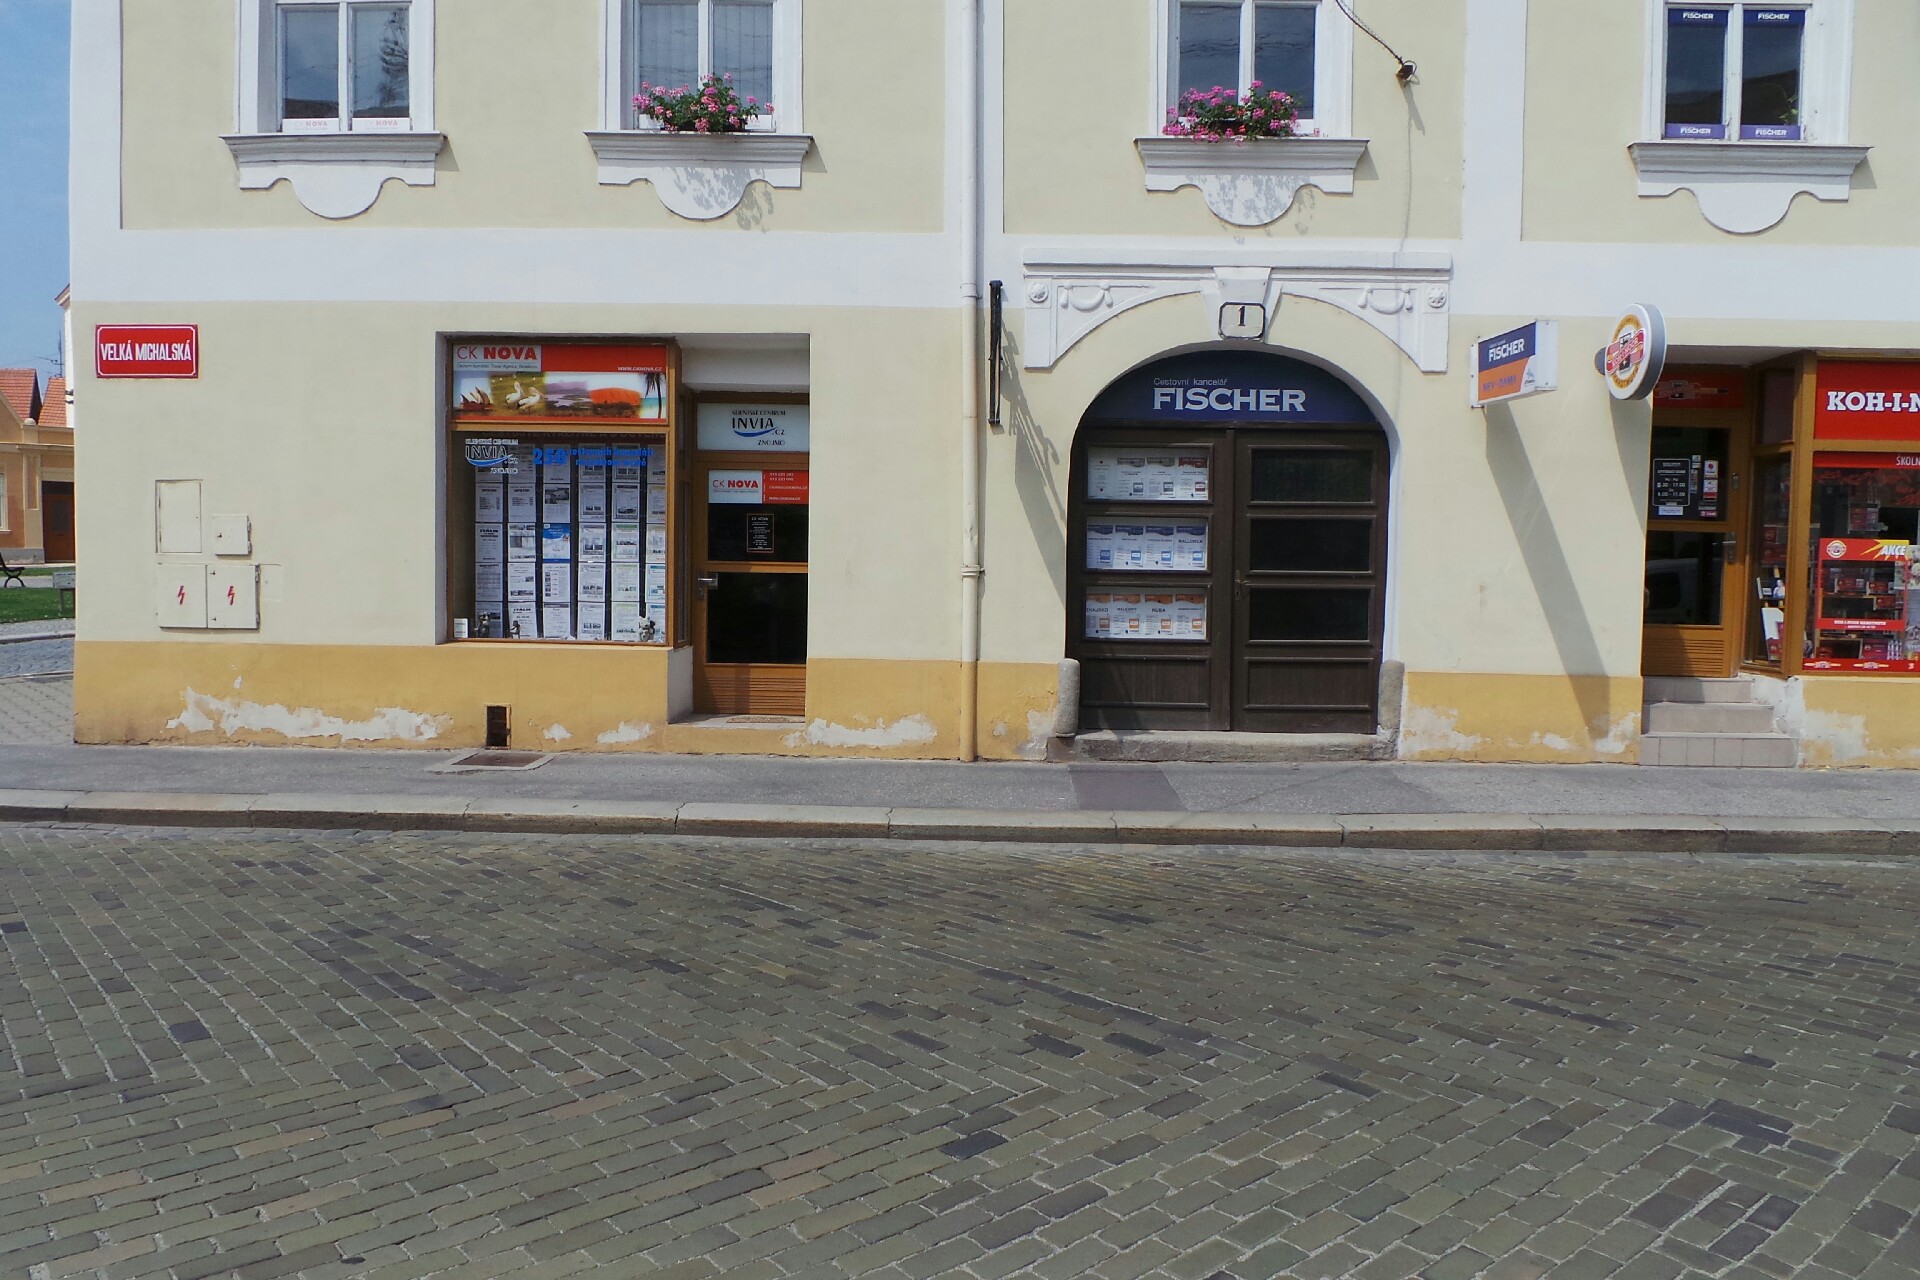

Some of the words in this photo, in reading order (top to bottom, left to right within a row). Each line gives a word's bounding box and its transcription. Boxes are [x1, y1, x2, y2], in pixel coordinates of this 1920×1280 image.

[1758, 12, 1790, 20] FISCHER
[1755, 128, 1787, 136] FISCHER
[1238, 306, 1246, 326] 1
[101, 340, 134, 360] VELKÁ
[135, 340, 192, 360] MICHALSKÁ
[457, 346, 478, 359] CK
[483, 346, 537, 360] NOVA
[1488, 338, 1524, 362] FISCHER
[1154, 378, 1188, 386] Cestovní
[1194, 378, 1228, 386] kancelář
[1153, 388, 1306, 412] FISCHER
[732, 418, 774, 429] INVIA
[465, 446, 508, 458] INVIA
[532, 447, 567, 465] 250
[712, 479, 724, 487] CK
[728, 480, 758, 488] NOVA
[1880, 544, 1906, 556] AKCE
